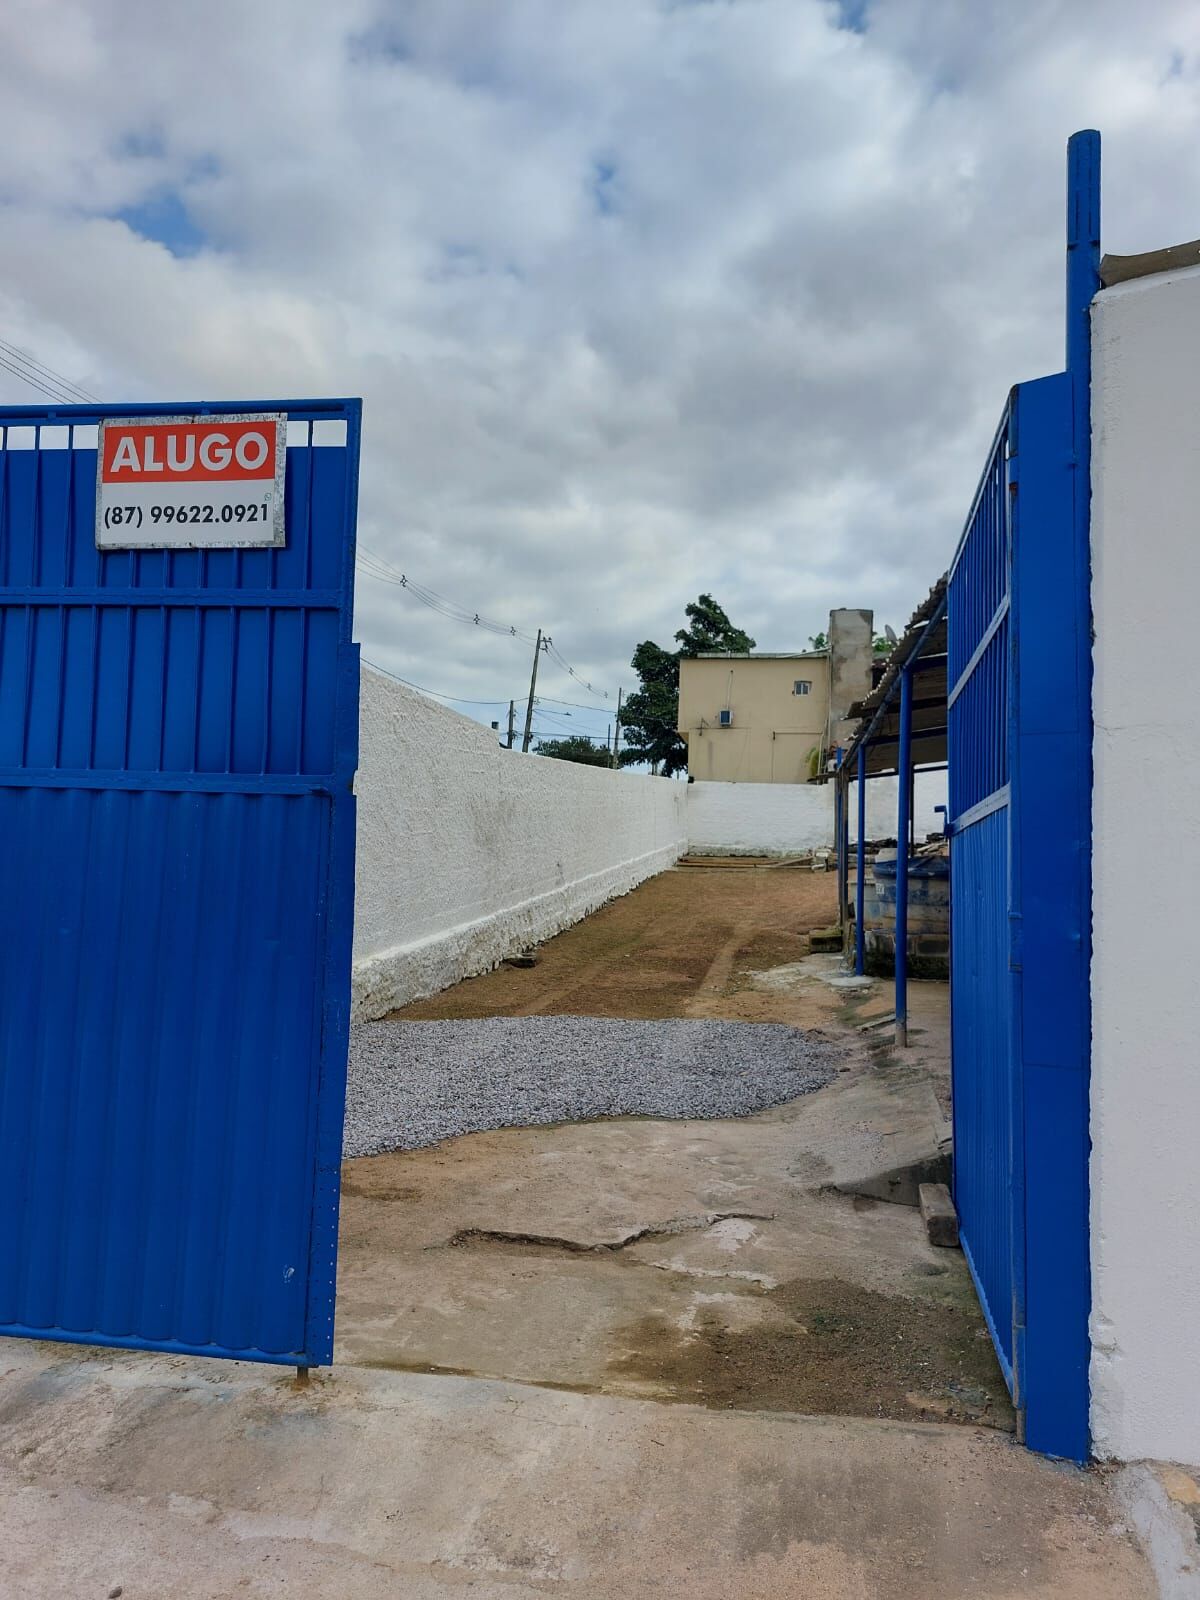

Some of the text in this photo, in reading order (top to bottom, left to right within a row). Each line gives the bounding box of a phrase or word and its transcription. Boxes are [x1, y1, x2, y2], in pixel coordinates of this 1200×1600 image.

[110, 431, 269, 473] ALUGO
[104, 503, 268, 529] (87) 99622.0921
